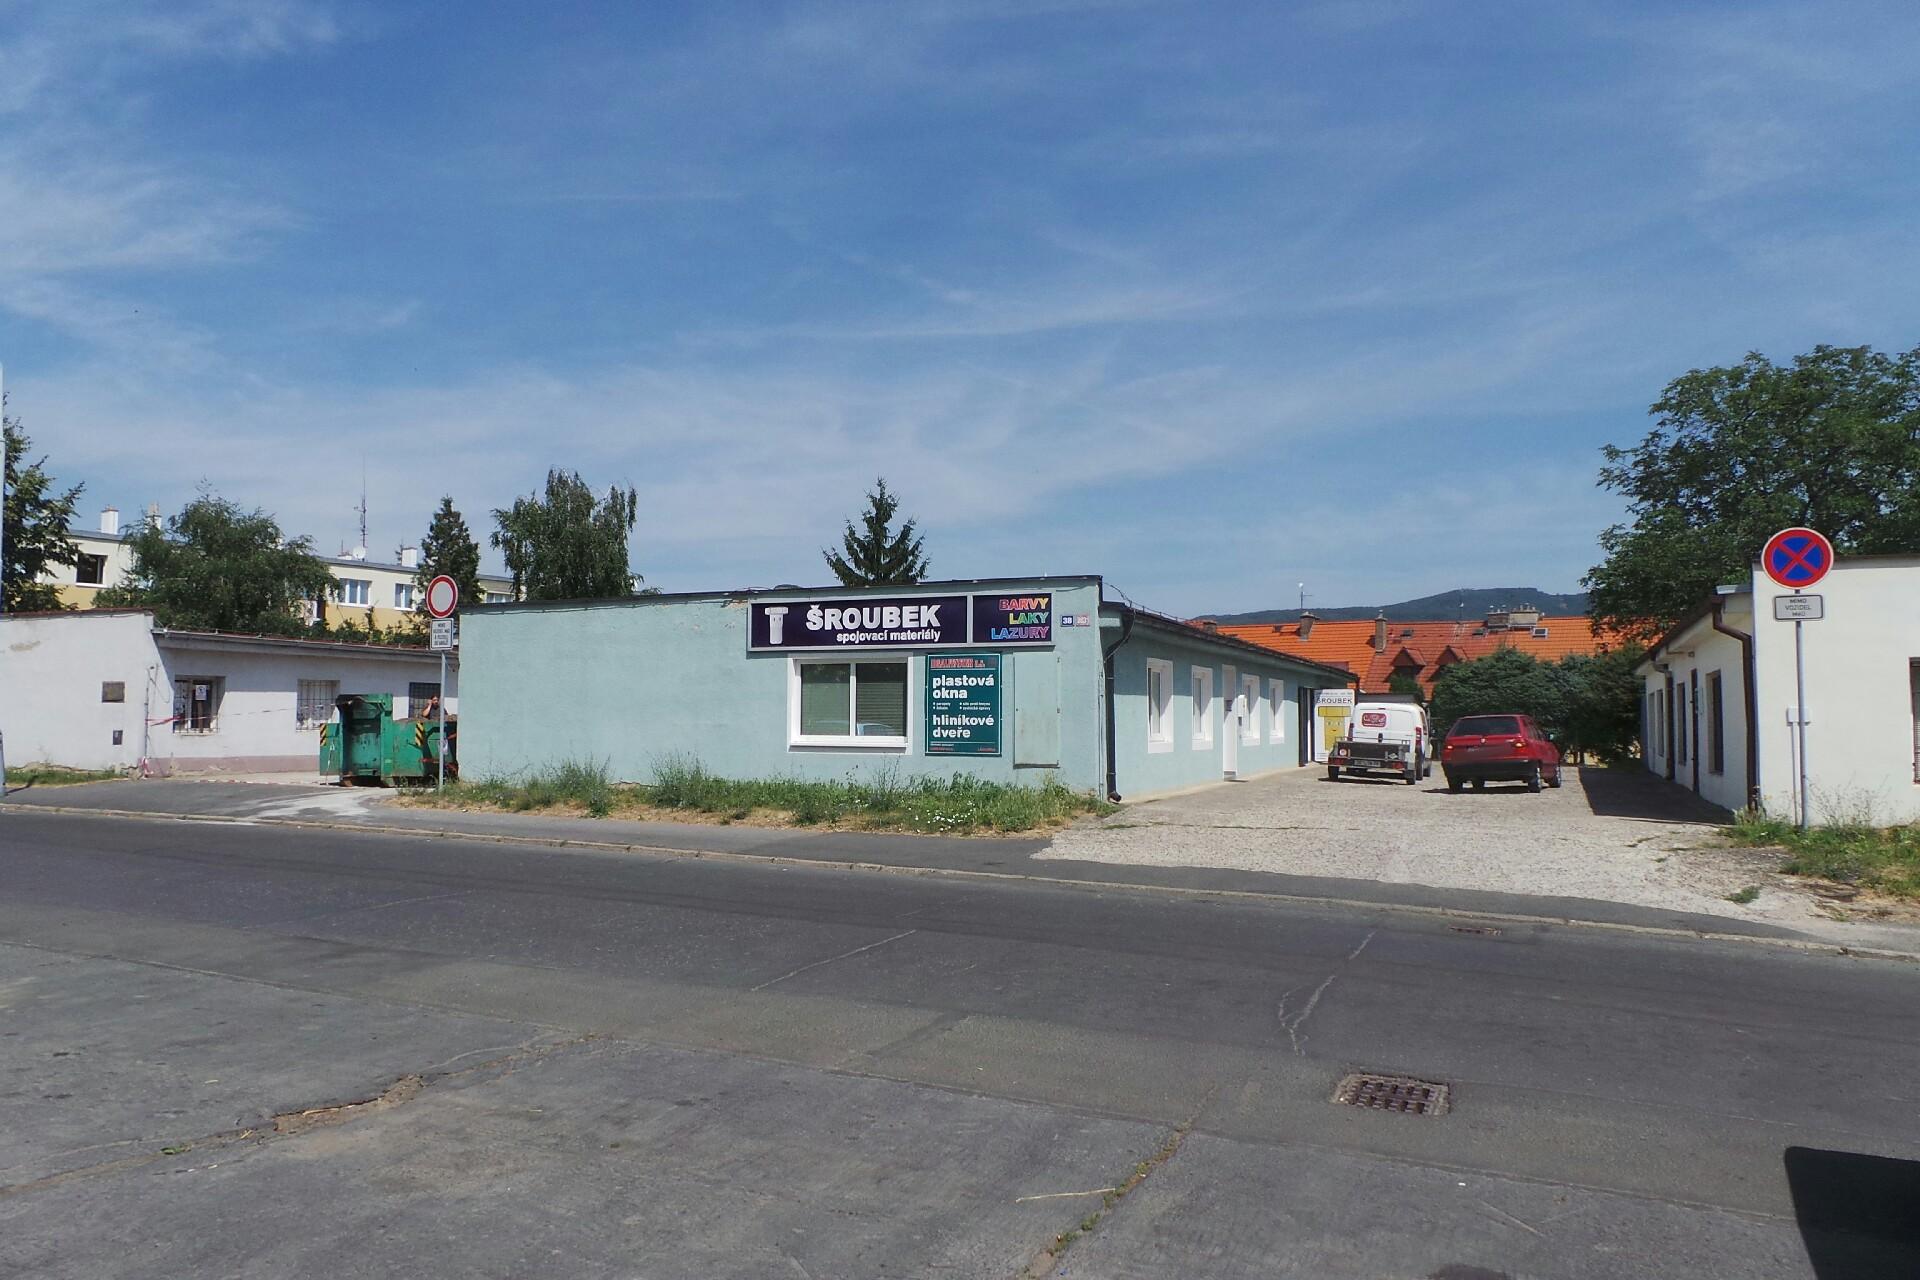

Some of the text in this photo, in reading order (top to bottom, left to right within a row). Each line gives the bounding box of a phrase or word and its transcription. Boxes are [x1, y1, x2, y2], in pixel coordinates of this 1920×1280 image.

[999, 598, 1049, 610] BARVY
[806, 604, 941, 631] ŠROUBEK
[1009, 612, 1049, 625] LAKY
[1062, 616, 1073, 625] 38
[836, 629, 941, 644] spojovací materiály
[991, 626, 1049, 640] LAZURY
[932, 674, 994, 688] plastová
[932, 687, 968, 699] okna
[932, 714, 994, 726] hliníkové
[932, 726, 971, 738] dveře
